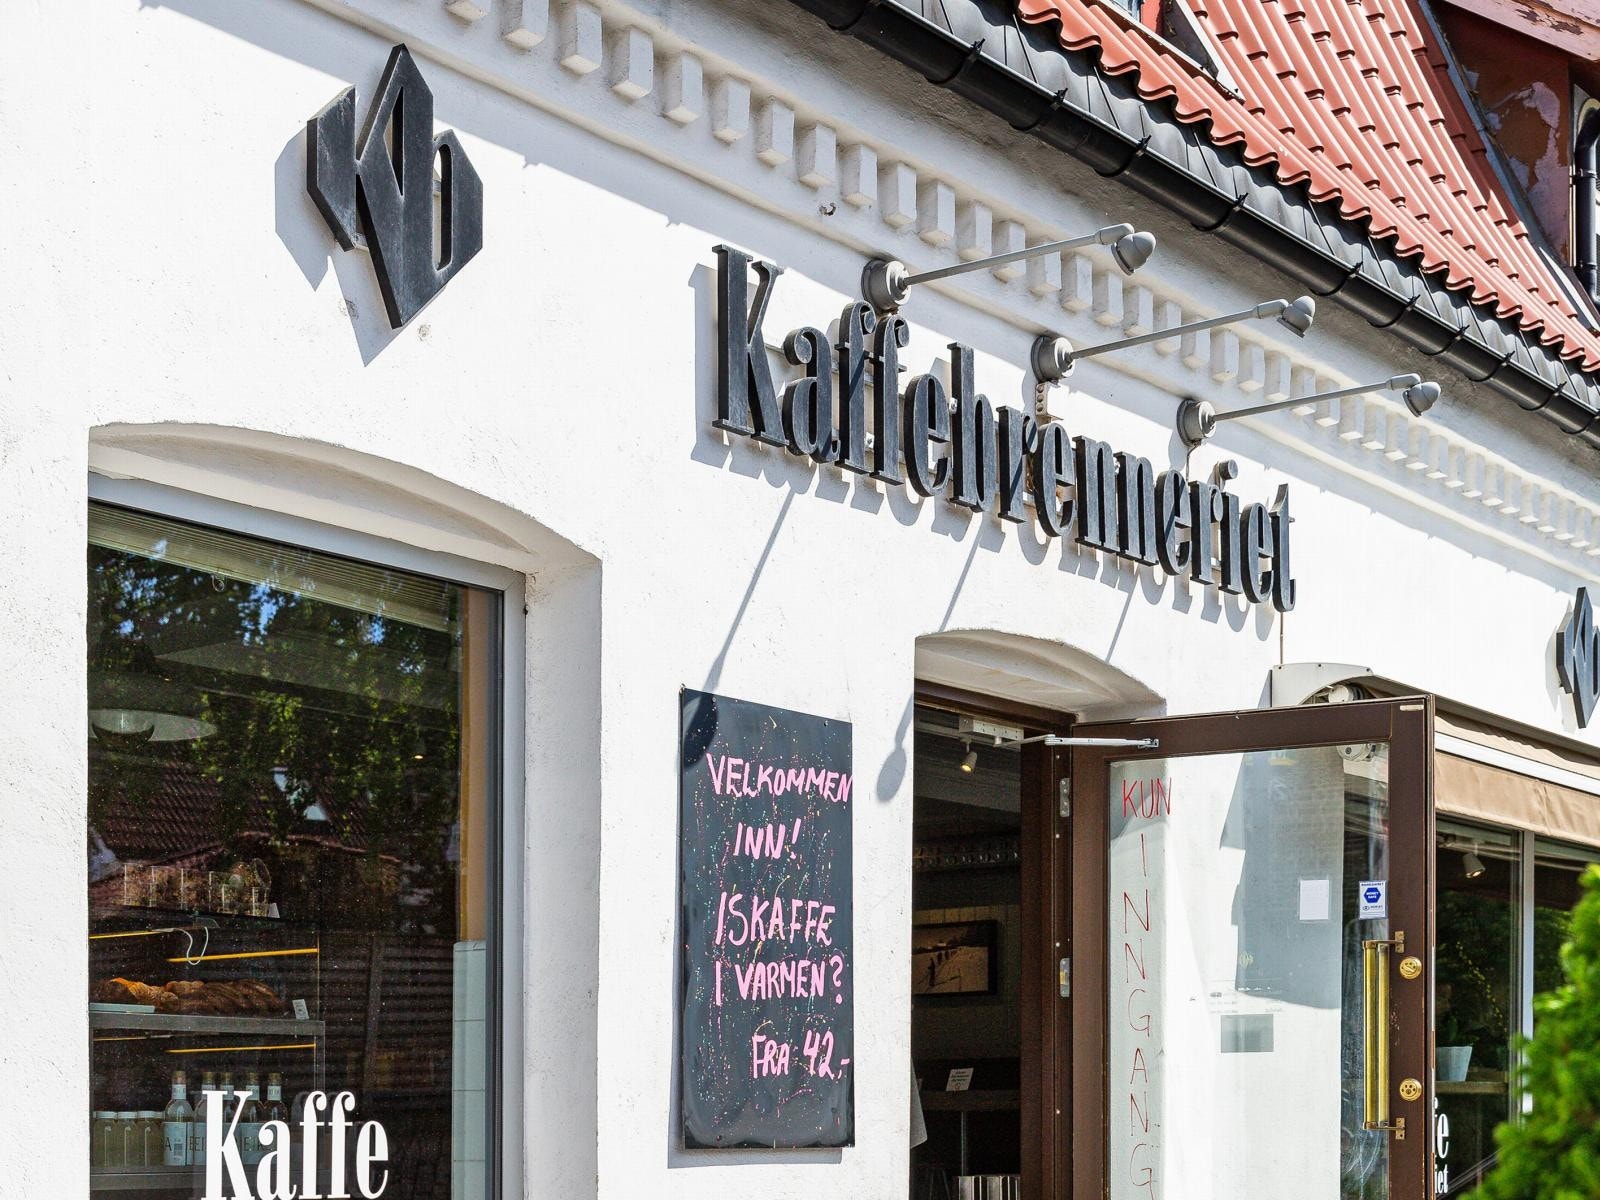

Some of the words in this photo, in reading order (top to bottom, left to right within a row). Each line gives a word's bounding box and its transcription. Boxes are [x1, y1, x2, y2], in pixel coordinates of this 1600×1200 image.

[712, 244, 1296, 613] Kaffebrenneriet
[706, 752, 853, 803] VELKOMMEN
[1122, 777, 1172, 819] KUN
[733, 818, 802, 860] INN!
[715, 891, 836, 946] ISKAFFE
[715, 962, 722, 1006] I
[736, 956, 845, 1005] VARMEN?
[753, 1034, 790, 1079] FRA
[803, 1028, 851, 1079] 42,-
